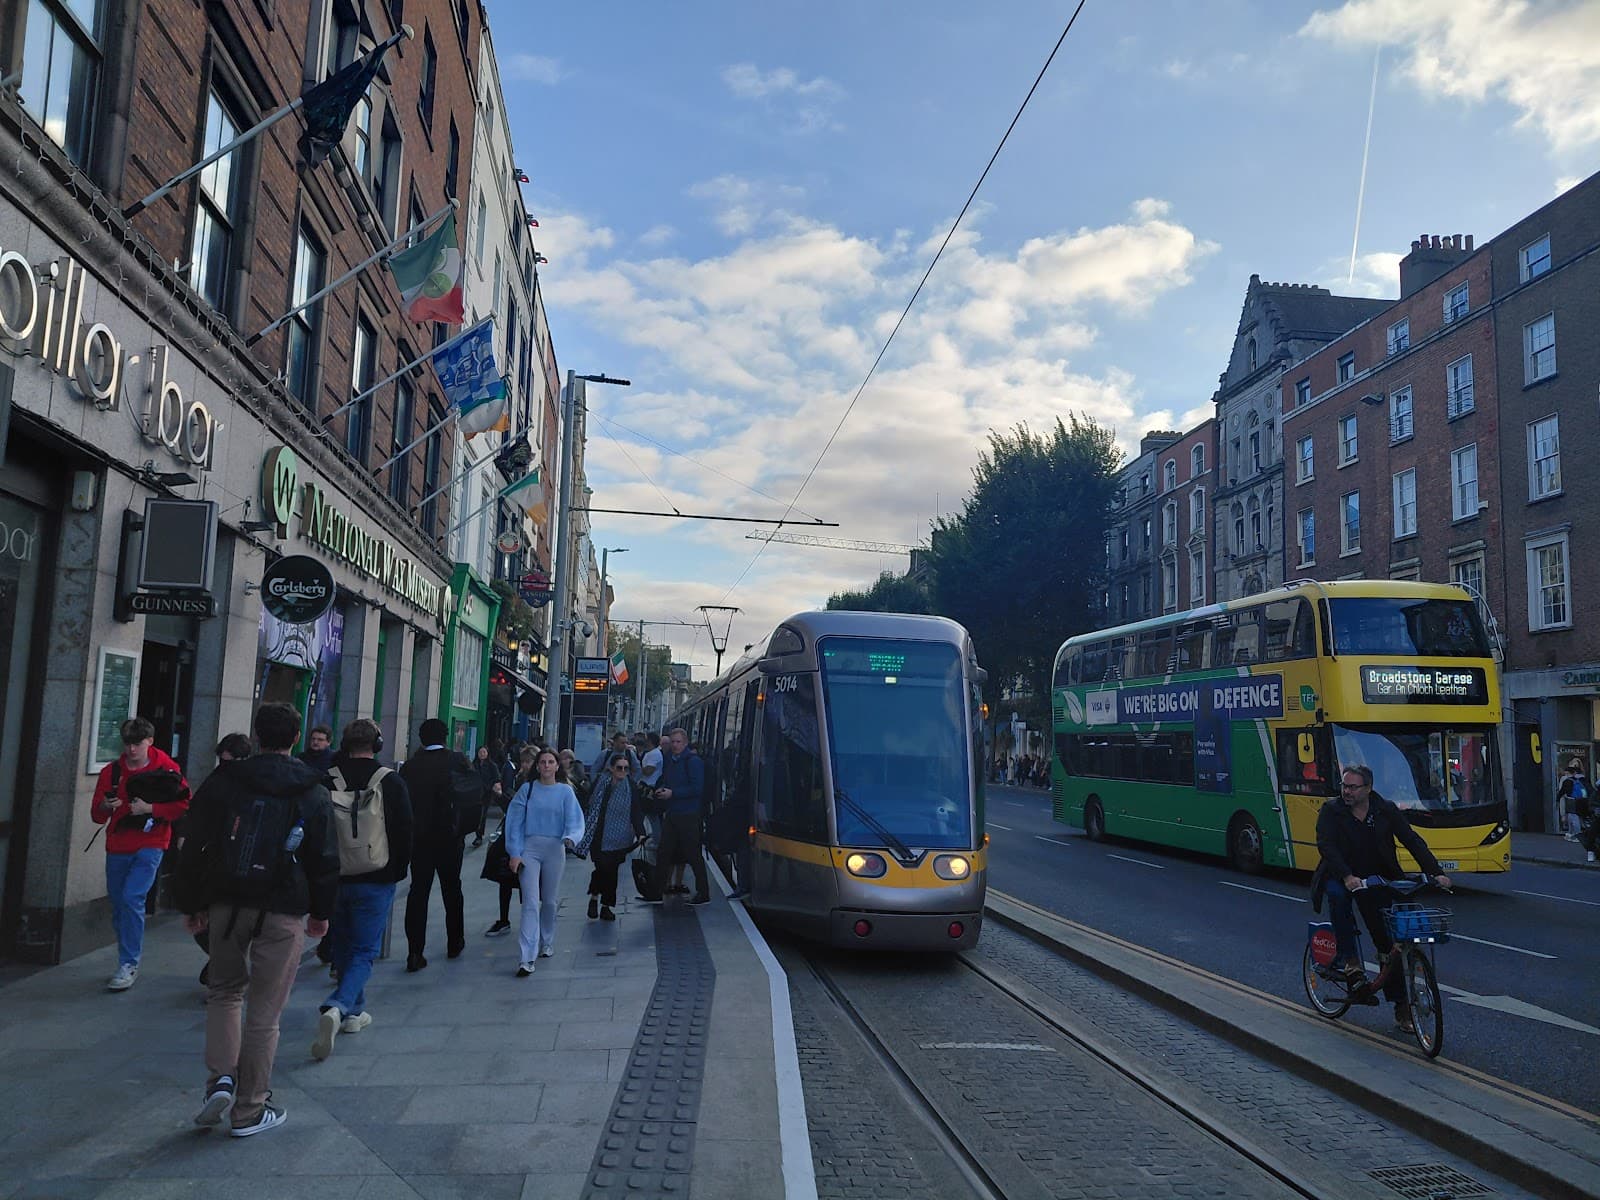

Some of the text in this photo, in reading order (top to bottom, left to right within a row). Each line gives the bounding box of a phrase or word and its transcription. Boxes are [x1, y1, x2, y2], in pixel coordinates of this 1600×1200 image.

[157, 345, 225, 470] bar
[307, 483, 381, 579] NATIONAL
[383, 540, 407, 595] WAX
[405, 559, 440, 617] MUSEUM
[268, 577, 327, 598] Carlsberg
[132, 595, 207, 613] GUINNESS
[774, 674, 798, 693] 5014
[1369, 670, 1473, 685] Broadstone Garage
[1124, 683, 1280, 715] WE'RE BIG ON DEFENCE
[1395, 683, 1406, 695] An
[1435, 683, 1467, 696] Leathan
[1091, 702, 1103, 712] VISA
